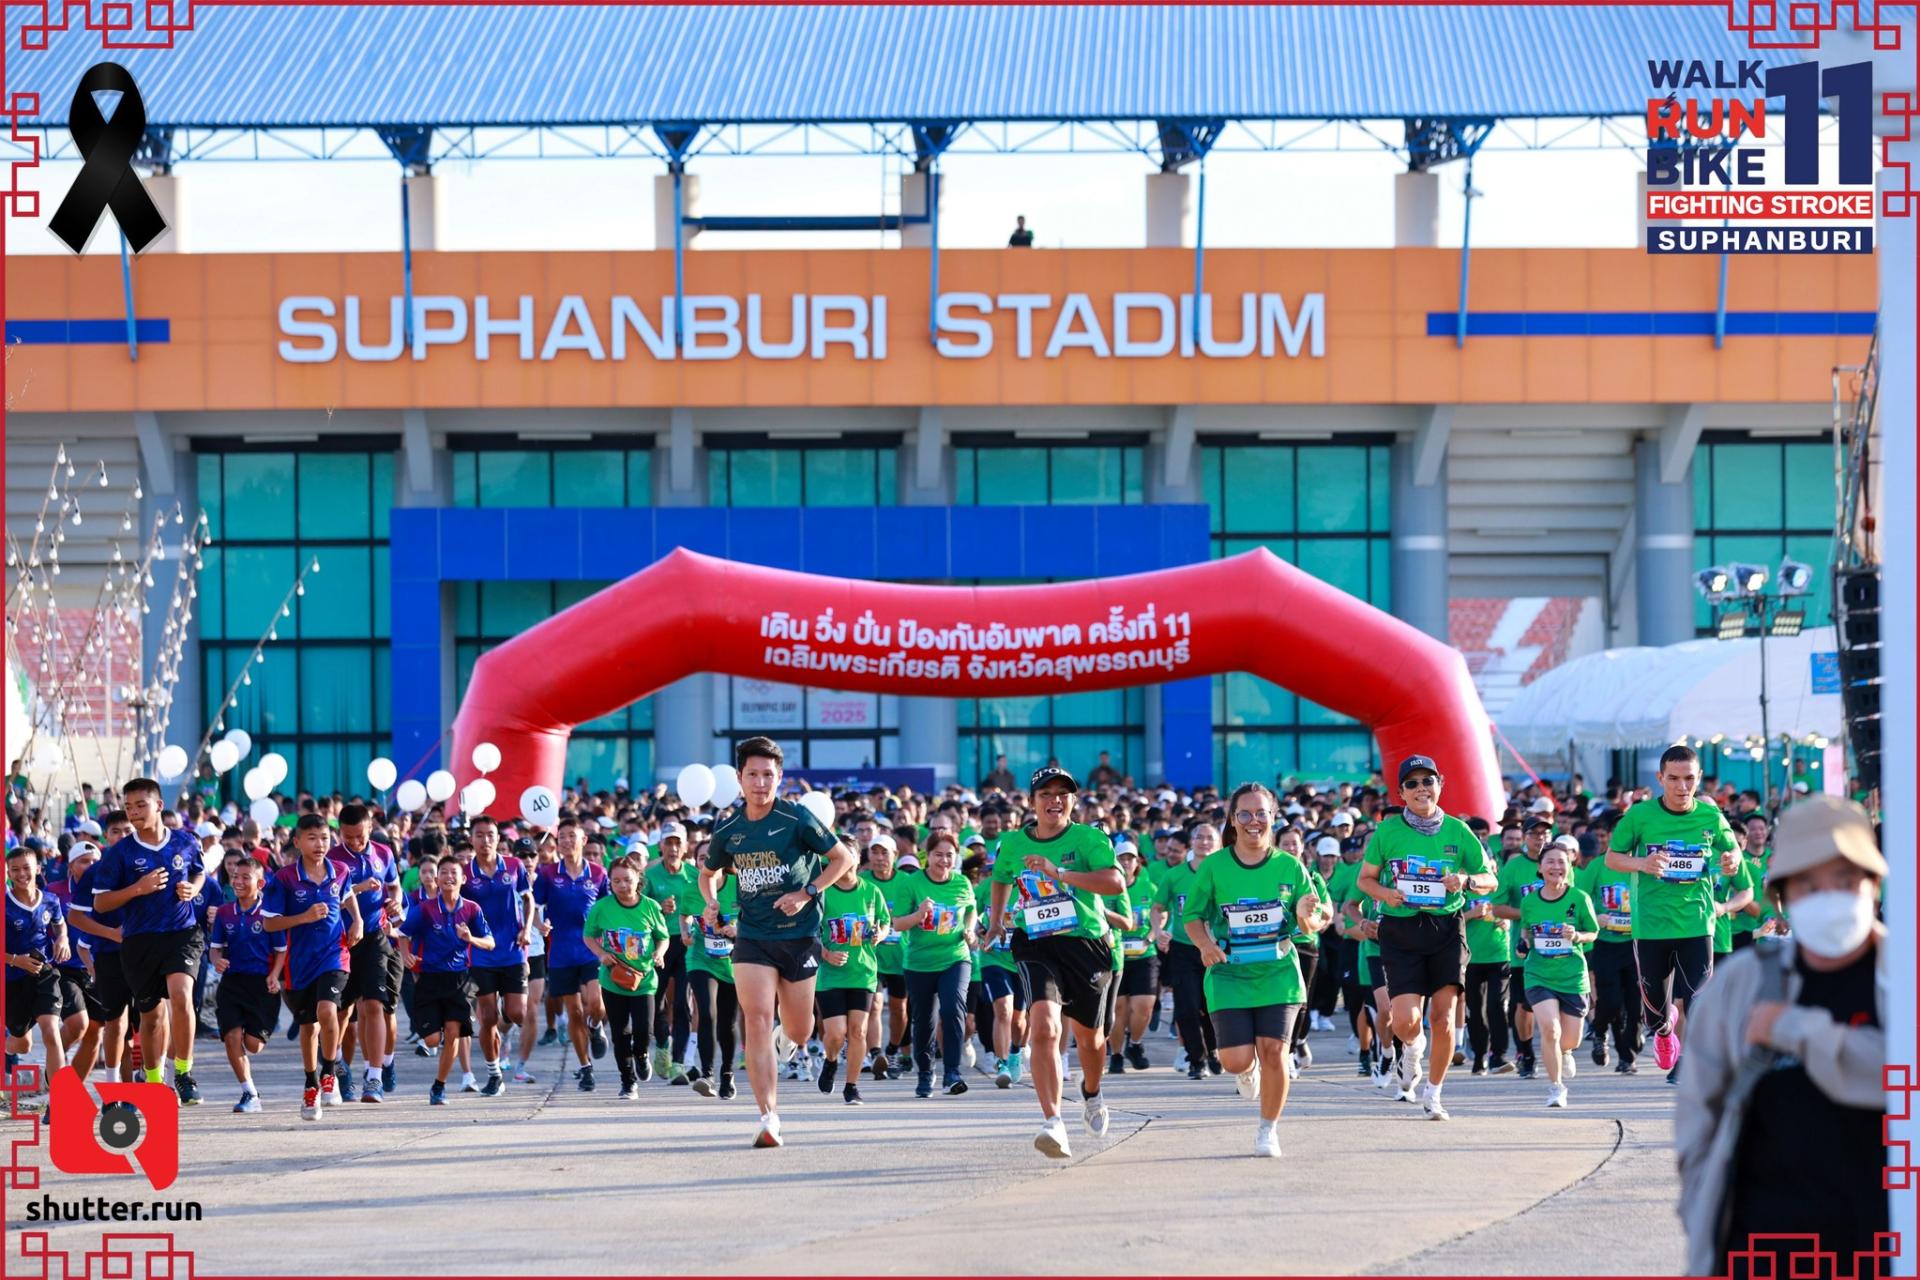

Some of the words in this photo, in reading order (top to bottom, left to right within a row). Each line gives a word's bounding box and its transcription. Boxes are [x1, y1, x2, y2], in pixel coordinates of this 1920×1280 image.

[278, 294, 887, 363] SUPHANBURI
[936, 291, 1326, 358] STADIUM
[760, 611, 808, 641] เดิน
[815, 607, 847, 644] วิ่ง
[853, 609, 891, 647] ปั่น
[898, 618, 1082, 652] ป้องกันอัมพาต
[1088, 603, 1157, 644] ครั้งที่
[1163, 612, 1191, 638] 11
[764, 644, 961, 680] เฉลิมพระเกียรติ
[967, 637, 1191, 682] จังหวัดสุพรรณบุรี
[821, 710, 867, 724] 2025
[1031, 767, 1072, 785] SPO
[532, 794, 551, 812] 40
[1412, 884, 1430, 894] 135
[1037, 907, 1061, 920] 629
[1244, 913, 1269, 924] 628
[713, 940, 727, 949] 991
[1544, 940, 1562, 948] 230
